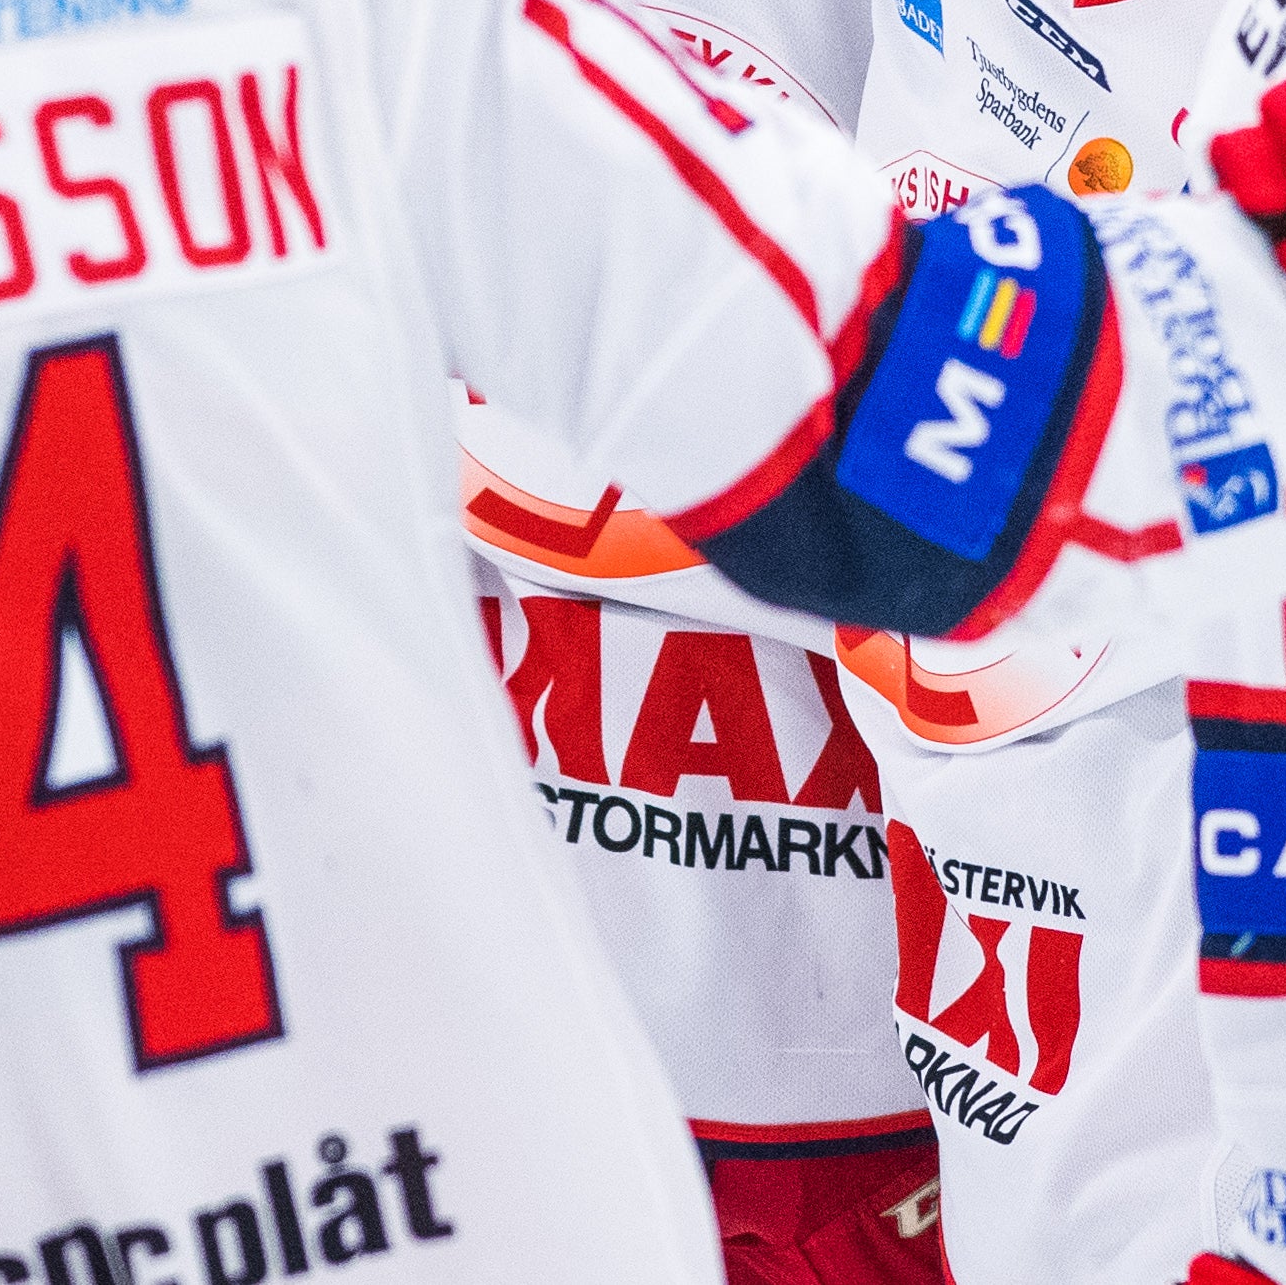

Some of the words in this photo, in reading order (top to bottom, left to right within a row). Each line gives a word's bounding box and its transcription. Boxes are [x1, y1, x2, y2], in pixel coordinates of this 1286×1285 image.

[966, 36, 1067, 134] Tjustbygdens
[975, 77, 1043, 150] Sparbank
[896, 1019, 1040, 1146] RKNAD
[192, 1123, 456, 1285] plåt
